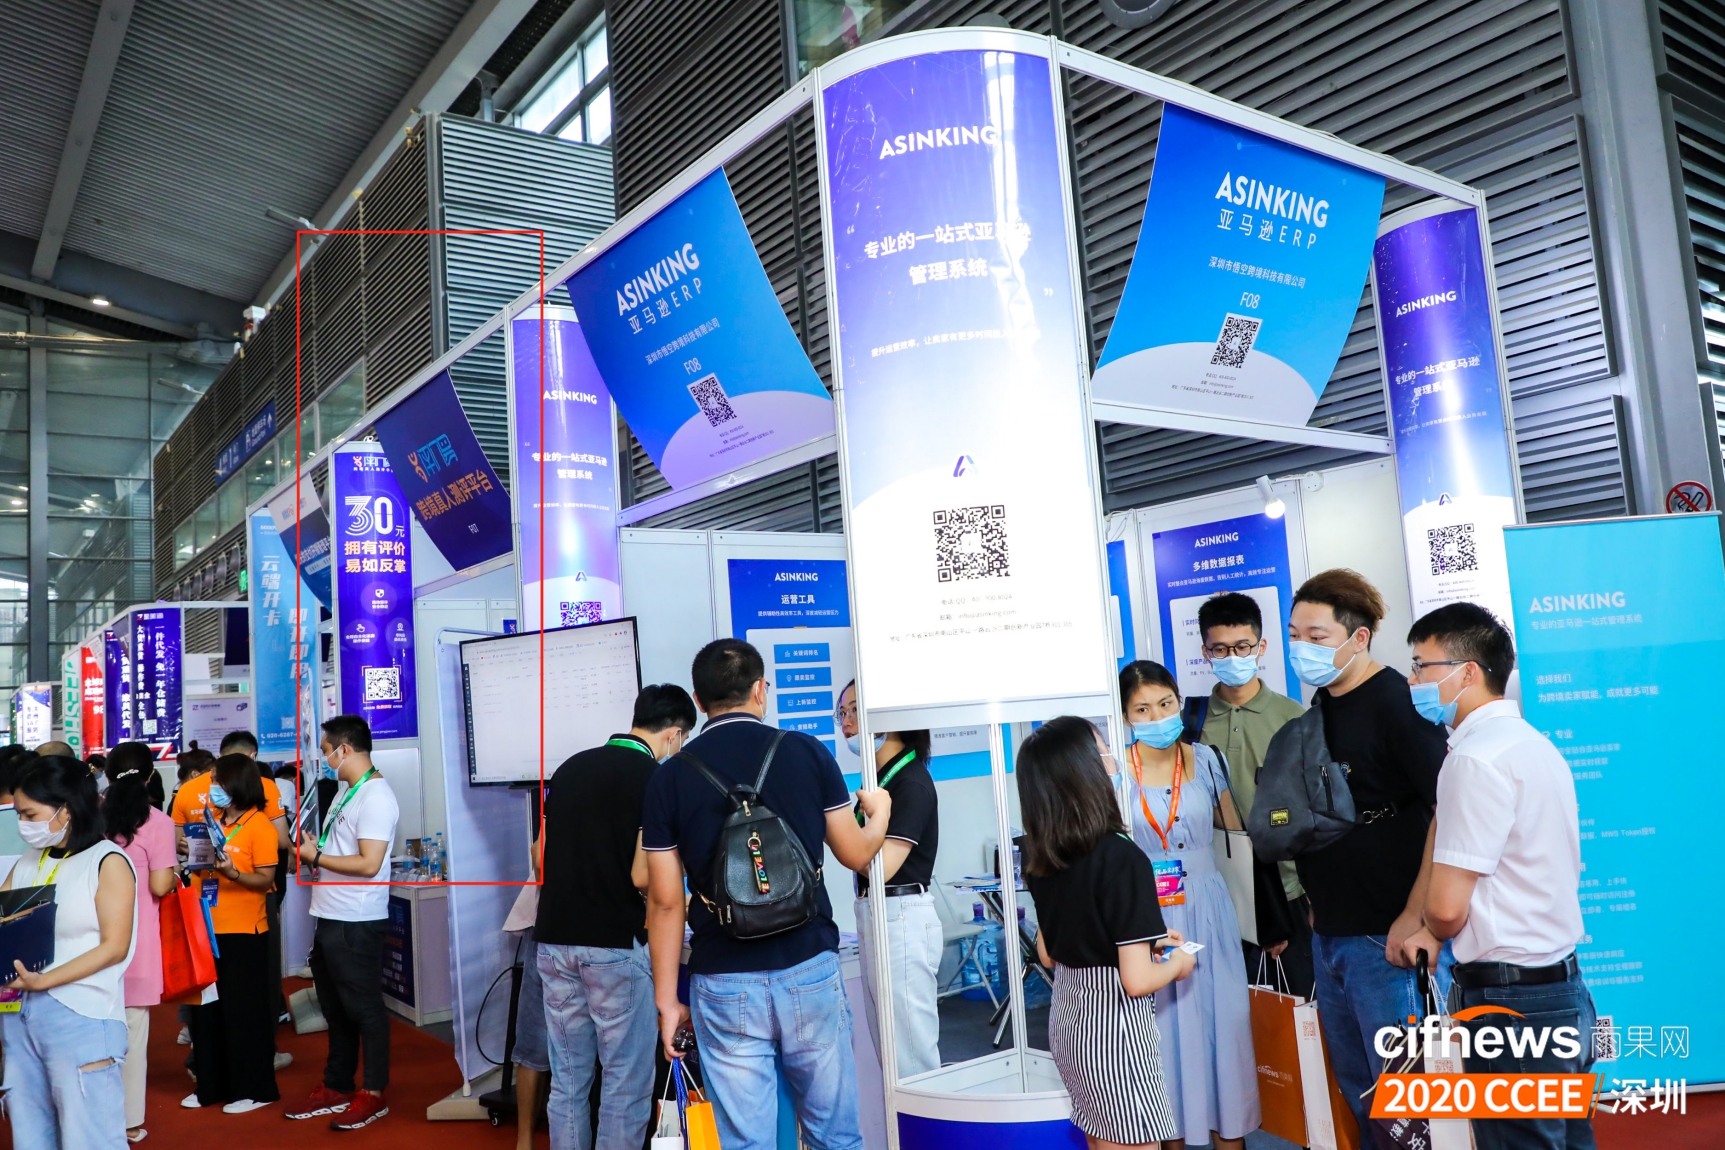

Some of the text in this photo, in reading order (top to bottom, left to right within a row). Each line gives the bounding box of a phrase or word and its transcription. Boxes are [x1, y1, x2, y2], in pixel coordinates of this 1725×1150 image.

[879, 125, 1001, 159] ASINKING
[1215, 171, 1330, 228] ASINKING
[1217, 208, 1317, 249] 亚马逊ERP
[616, 242, 700, 316] ASINKING
[909, 257, 988, 285] 管理系统
[1208, 256, 1306, 288] 深圳市悟空跨境科技有限公司
[628, 277, 702, 335] 亚马逊ERP
[1240, 291, 1261, 309] F08
[1396, 290, 1457, 318] ASINKING
[645, 317, 720, 365] 深圳市悟空跨境科技有限公司
[683, 357, 701, 375] F08
[543, 390, 597, 404] ASINKING
[557, 469, 593, 480] 管理系统
[415, 469, 494, 521] 跨境真人测评平台
[344, 496, 405, 537] 30 元
[344, 541, 405, 556] 拥有评价
[1194, 532, 1239, 548] ASINKING
[345, 558, 406, 573] 易如反掌
[1193, 554, 1244, 572] 多维数据报表
[774, 572, 818, 582] ASINKING
[261, 555, 281, 627] 云端开卡
[781, 594, 815, 605] 运营工具
[1529, 591, 1626, 613] ASINKING
[1531, 614, 1642, 630] 专业的亚马逊一站式管理系统
[154, 626, 166, 659] 一件代发
[288, 608, 309, 680] 即开即用
[1536, 673, 1571, 685] 选择我们
[64, 661, 79, 759] JEESHO
[266, 731, 303, 740] 020-6287-
[1555, 729, 1573, 739] 专业
[1601, 830, 1619, 838] MWS
